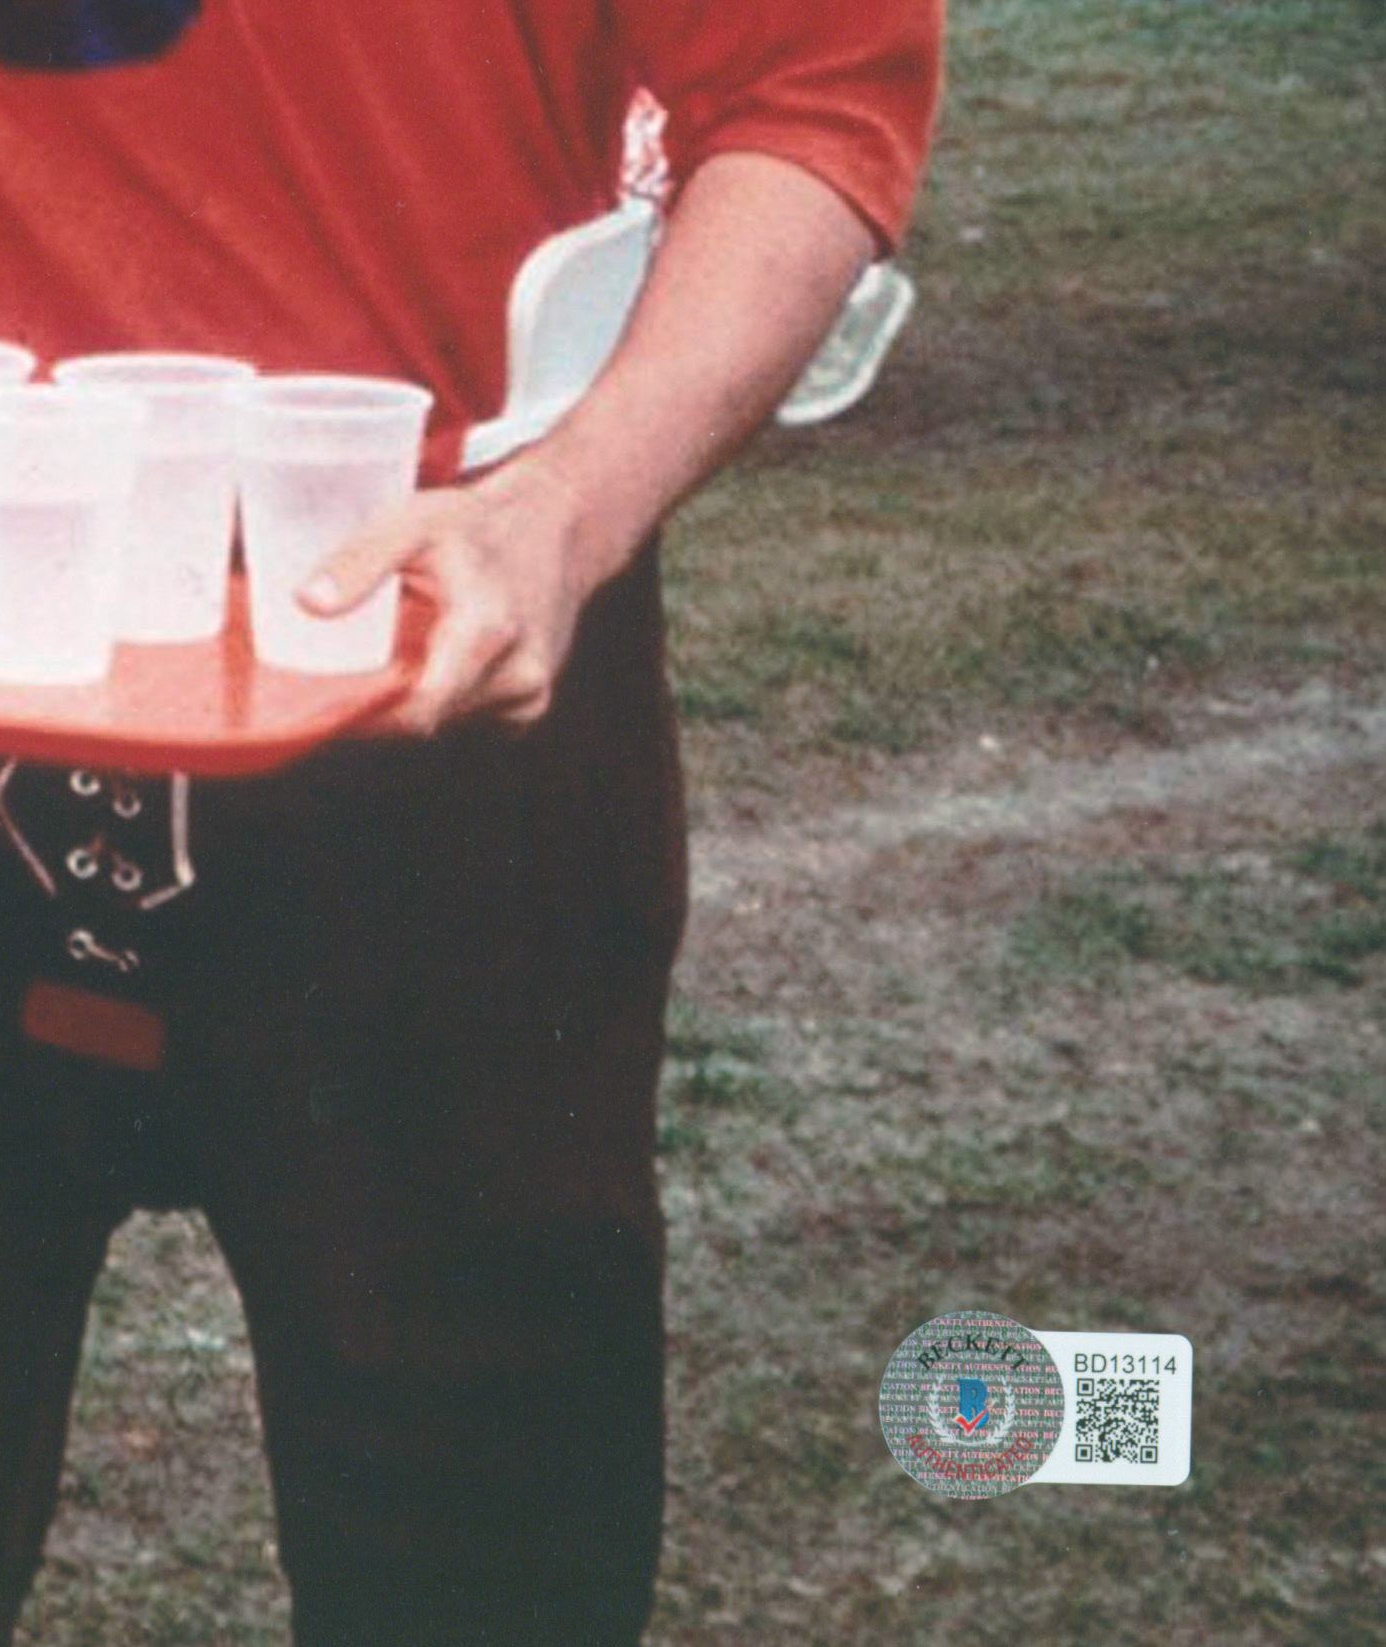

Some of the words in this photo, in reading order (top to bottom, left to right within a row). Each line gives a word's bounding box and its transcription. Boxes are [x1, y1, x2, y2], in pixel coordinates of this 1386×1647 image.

[917, 1333, 1030, 1372] BECKETT
[1074, 1353, 1177, 1375] BD13114
[907, 1434, 1035, 1482] AUTHENTICATED
